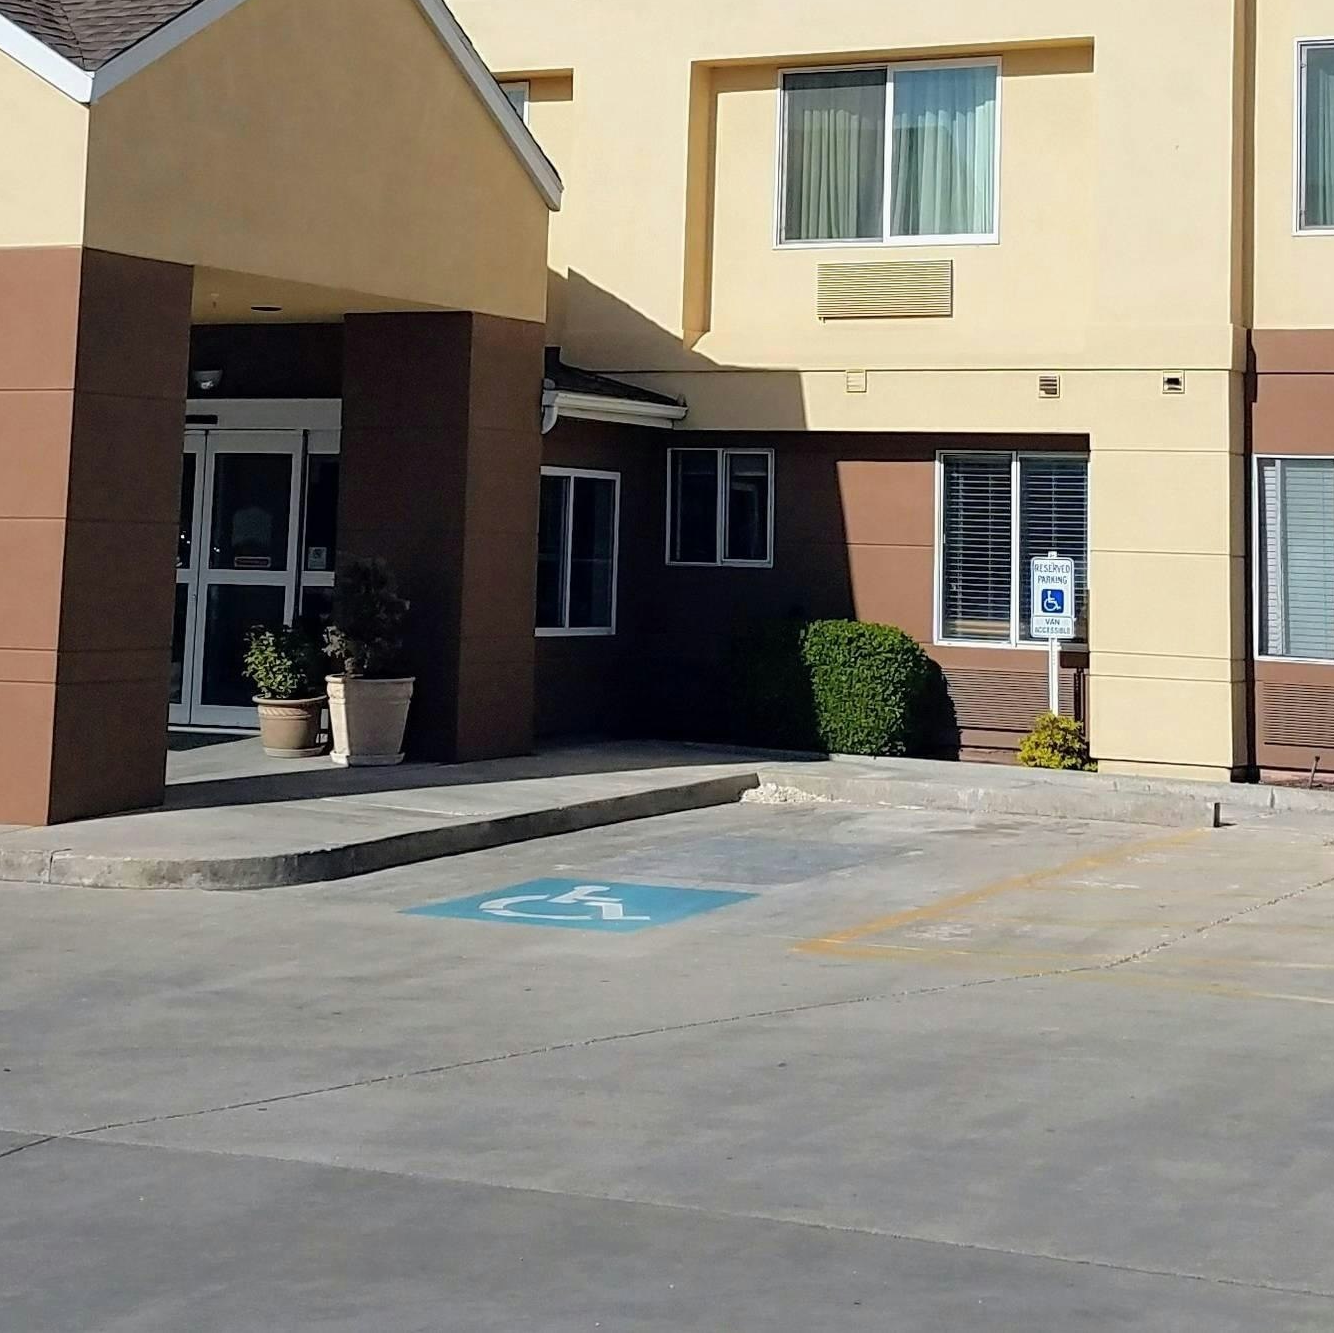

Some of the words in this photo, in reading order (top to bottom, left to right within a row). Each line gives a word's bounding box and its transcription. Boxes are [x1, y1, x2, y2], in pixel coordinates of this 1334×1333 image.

[1034, 563, 1071, 574] RESERVED
[1037, 575, 1068, 585] PARKING
[1045, 618, 1060, 626] VAN
